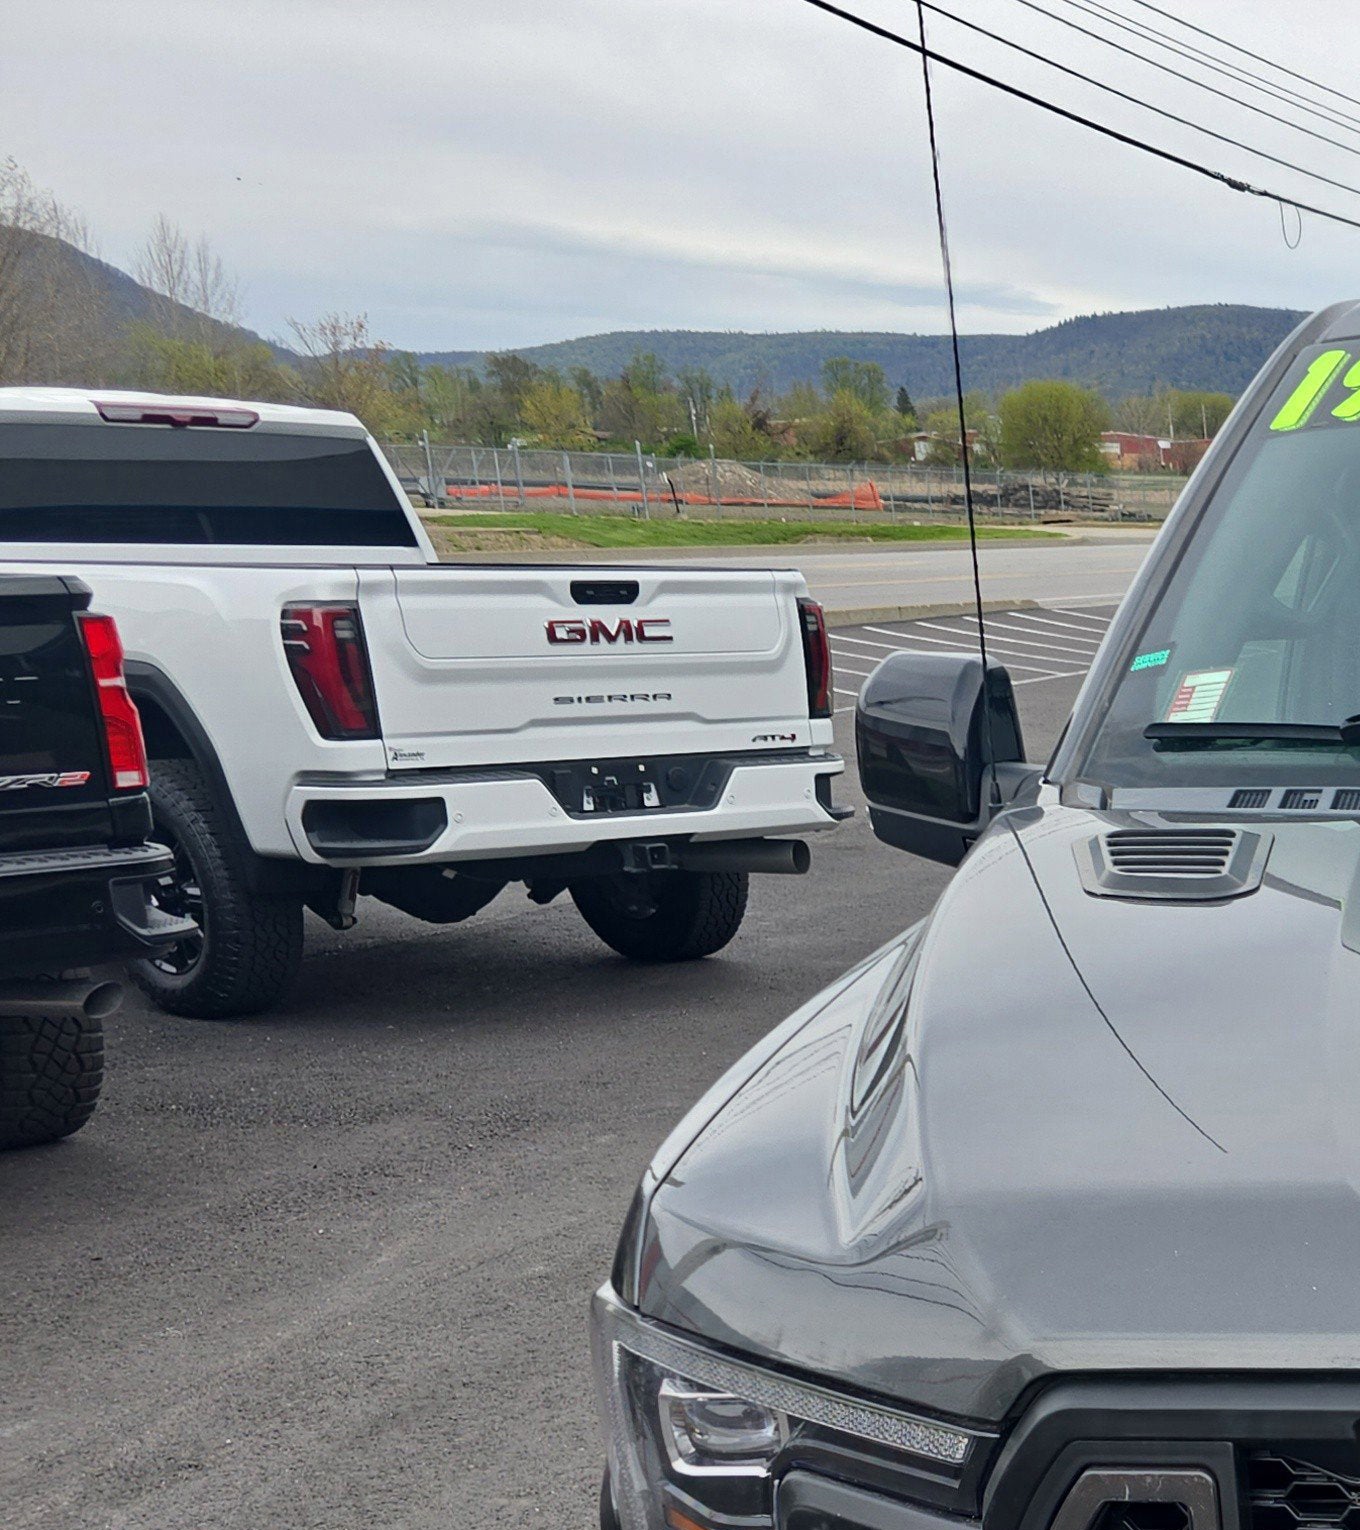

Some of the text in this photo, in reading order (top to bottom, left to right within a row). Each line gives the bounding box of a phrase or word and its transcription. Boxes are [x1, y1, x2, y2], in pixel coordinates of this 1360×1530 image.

[543, 618, 674, 645] GMC
[552, 692, 672, 705] SIERRA
[751, 733, 797, 743] AT4
